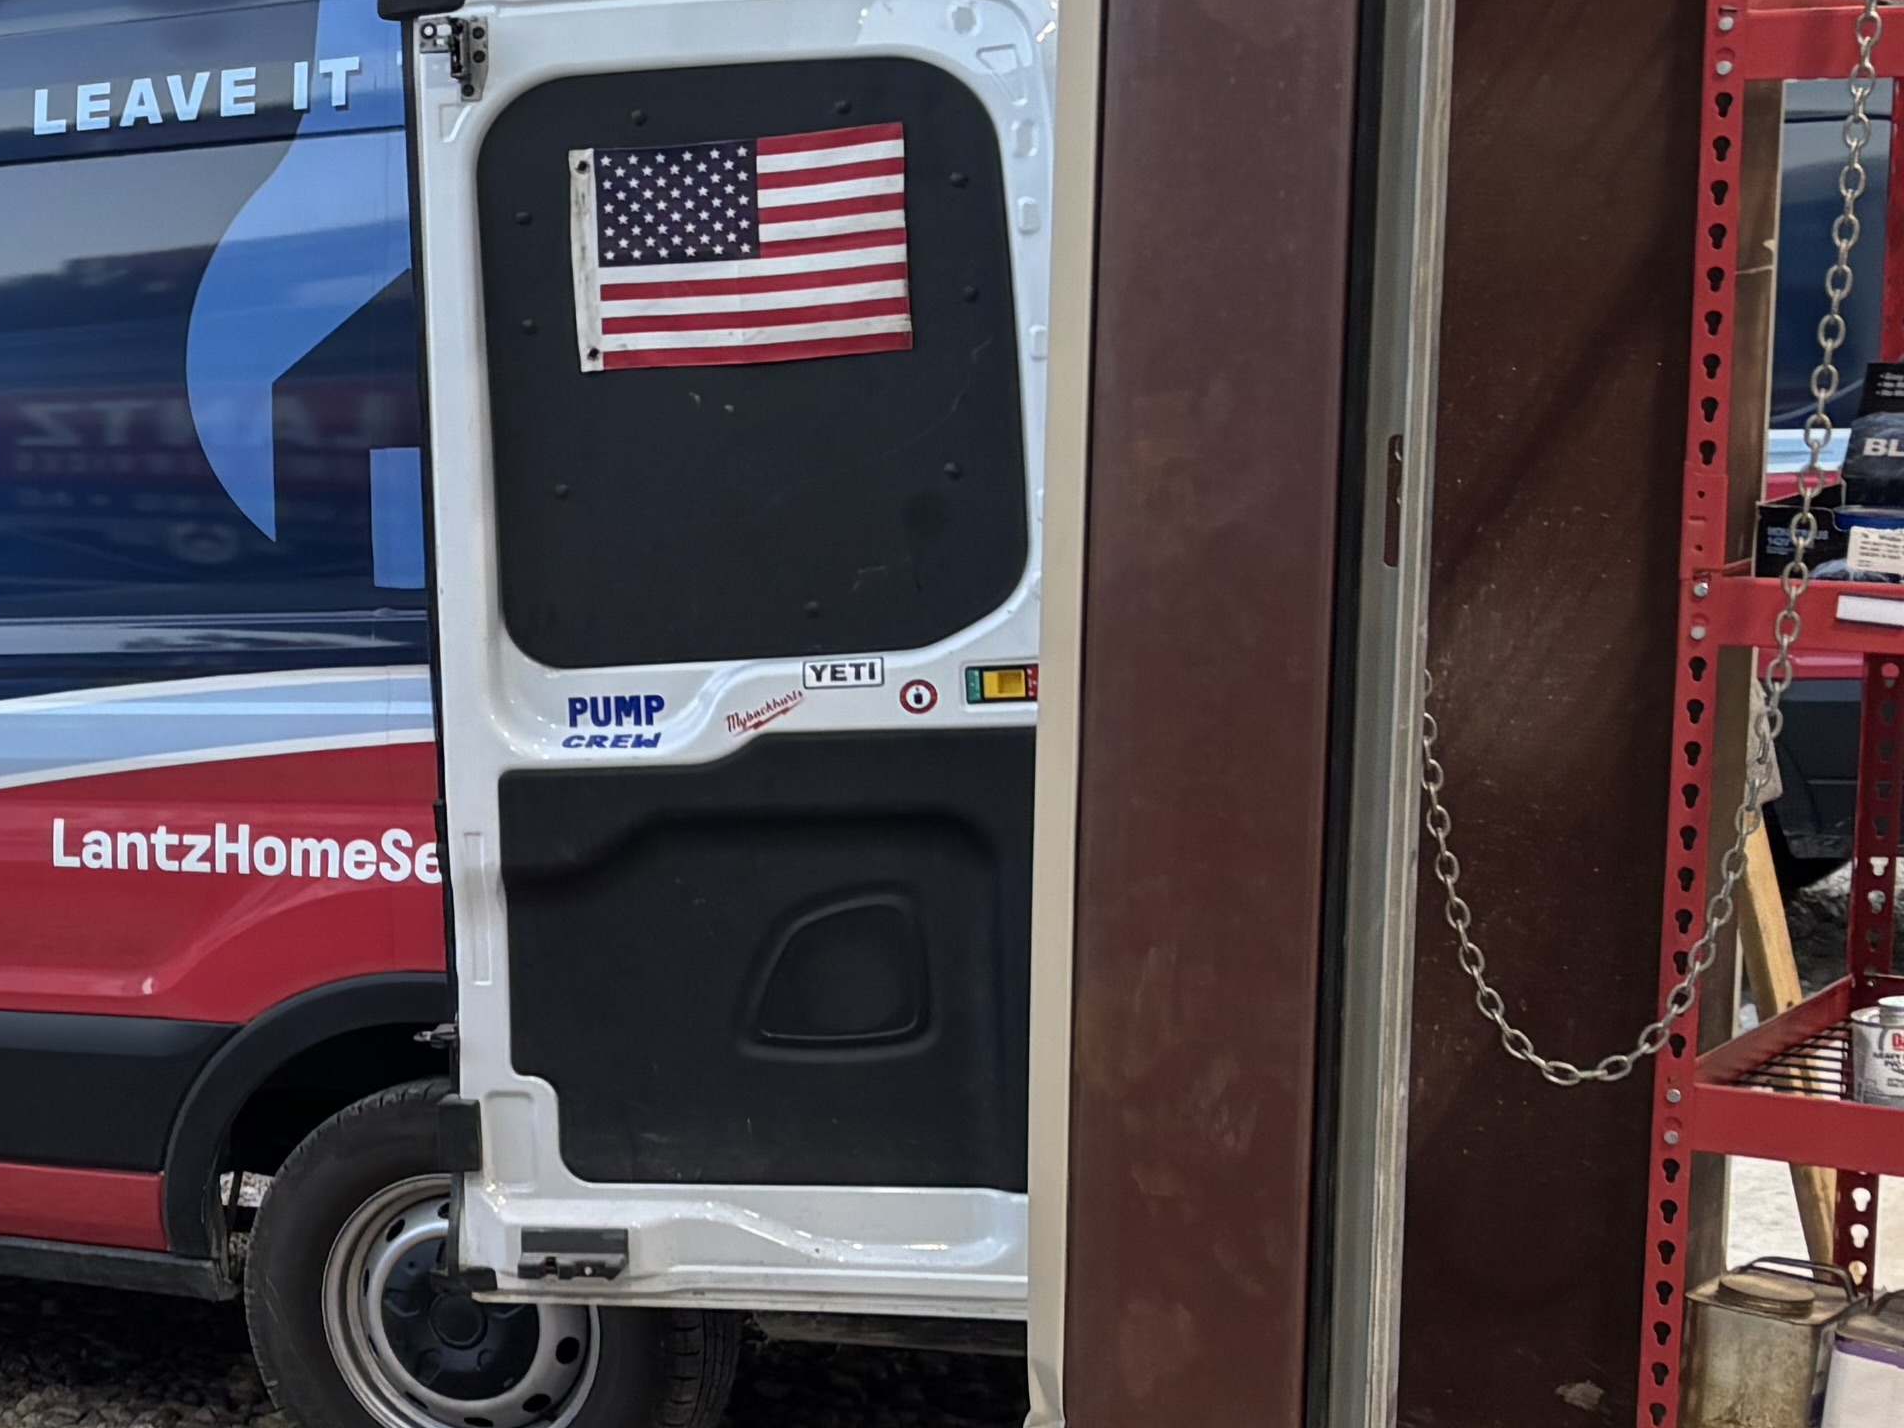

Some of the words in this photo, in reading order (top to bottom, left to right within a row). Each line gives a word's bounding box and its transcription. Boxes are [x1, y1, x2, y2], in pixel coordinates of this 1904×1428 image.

[33, 67, 257, 136] LEAVE
[293, 56, 360, 110] IT
[808, 662, 878, 683] YETI
[568, 695, 665, 728] PUMP
[561, 732, 662, 750] CREW
